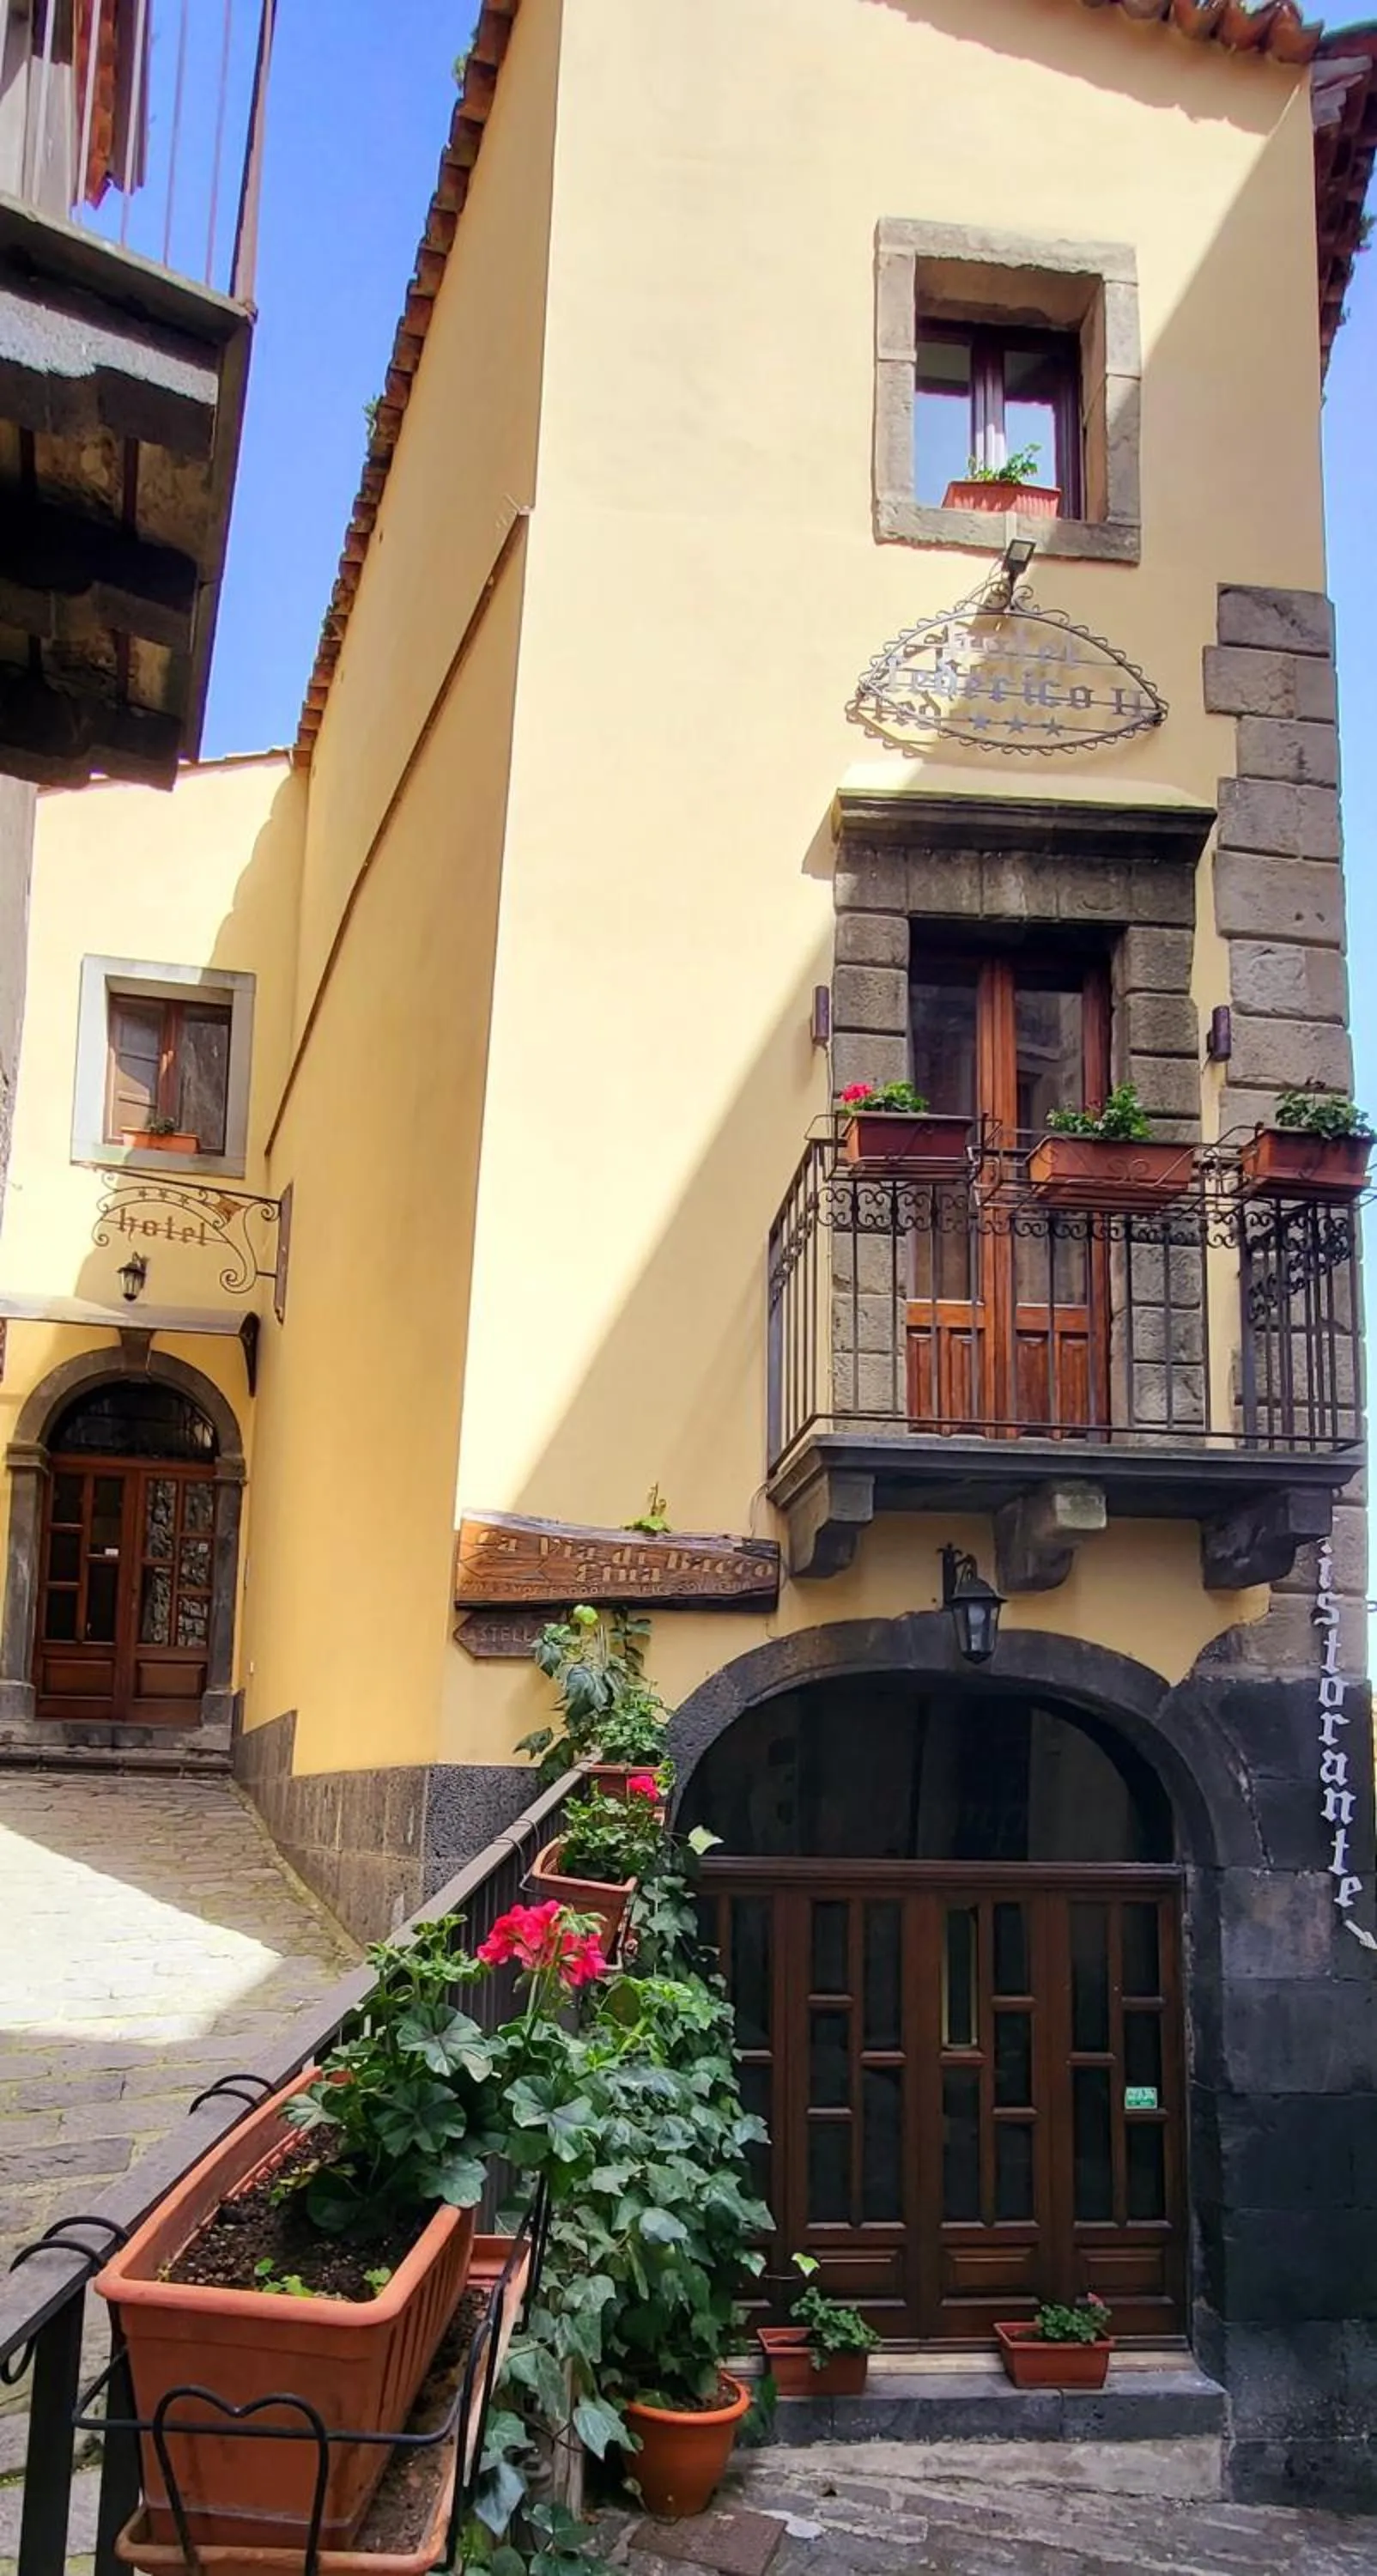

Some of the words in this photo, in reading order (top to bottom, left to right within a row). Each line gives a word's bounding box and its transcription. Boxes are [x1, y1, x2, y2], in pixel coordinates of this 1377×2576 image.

[117, 1206, 208, 1248] hotel
[612, 1546, 646, 1566] di
[666, 1550, 773, 1578] Bacco
[1313, 1535, 1363, 1908] istorante
